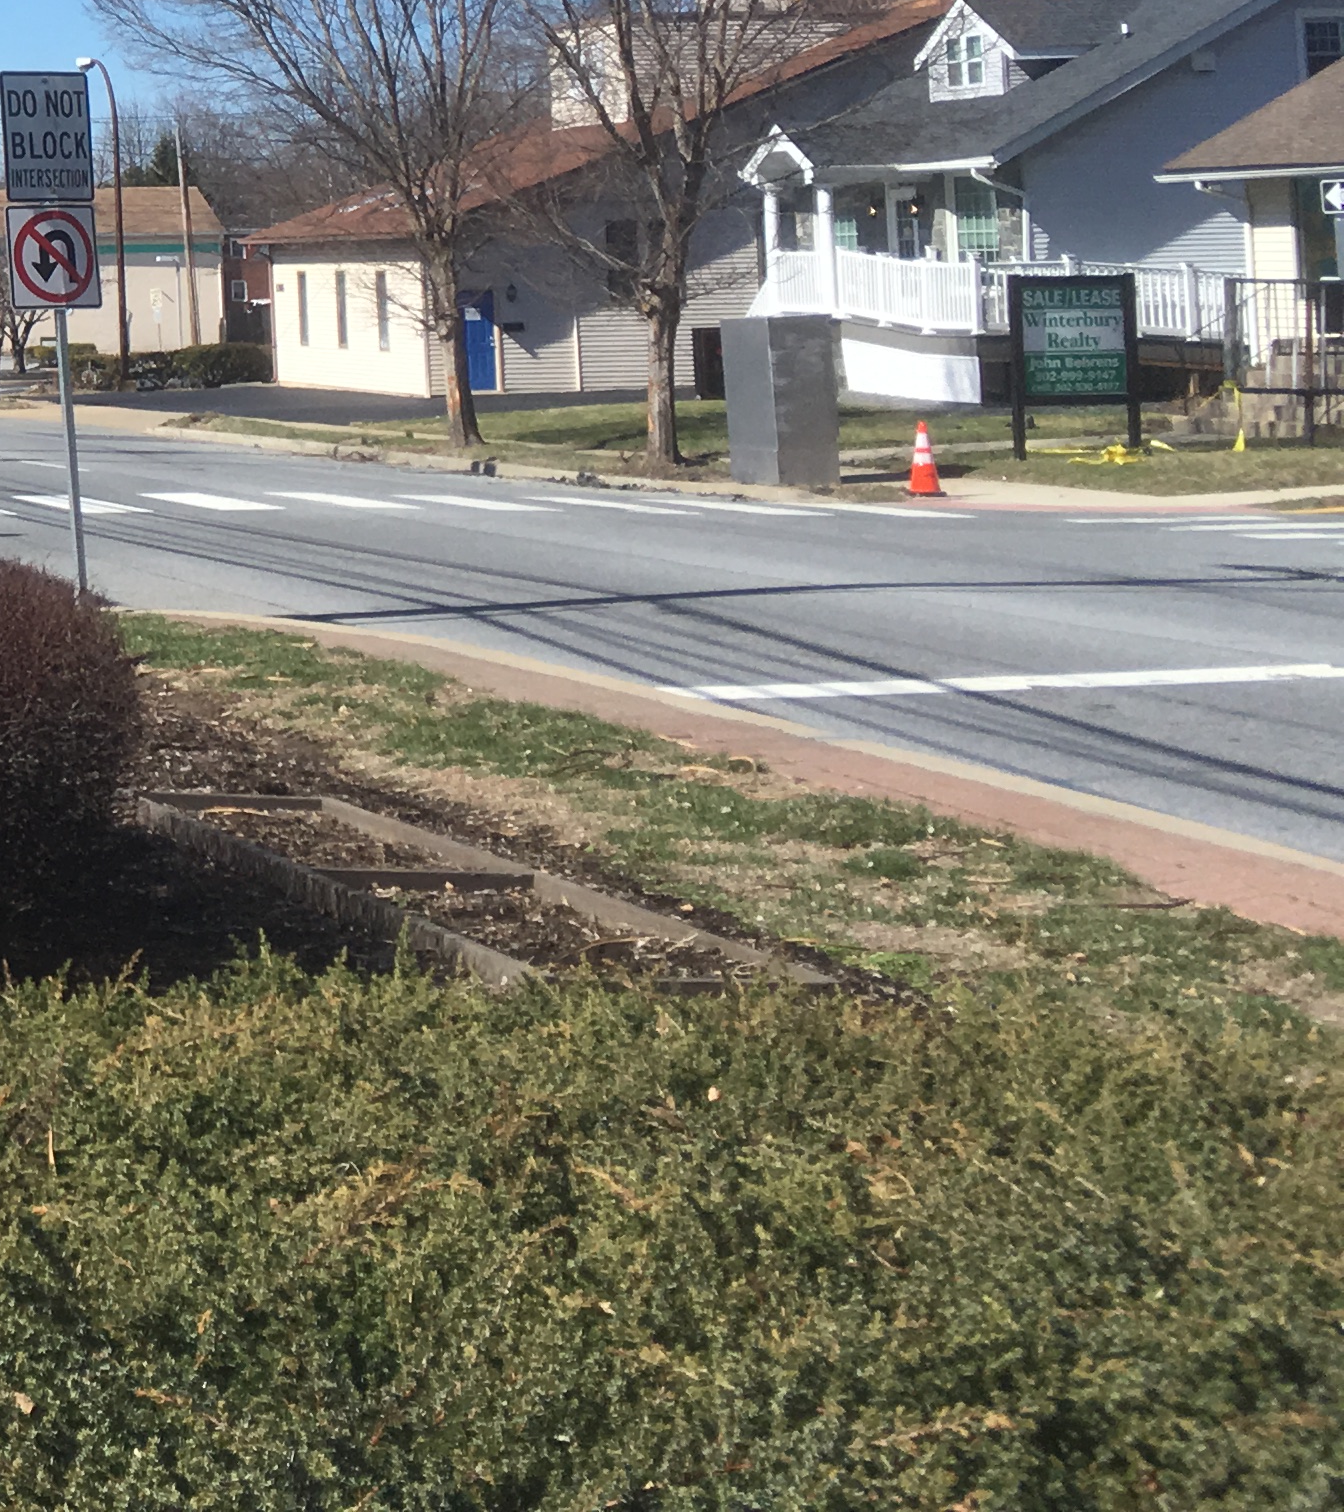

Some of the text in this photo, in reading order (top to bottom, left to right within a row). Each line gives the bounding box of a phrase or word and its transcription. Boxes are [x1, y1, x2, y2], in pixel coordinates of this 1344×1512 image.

[7, 89, 86, 119] DO NOT
[12, 130, 90, 160] BLOCK
[11, 167, 90, 189] INTERSECTION
[1023, 310, 1123, 330] Winterbury
[1046, 332, 1101, 349] Realty
